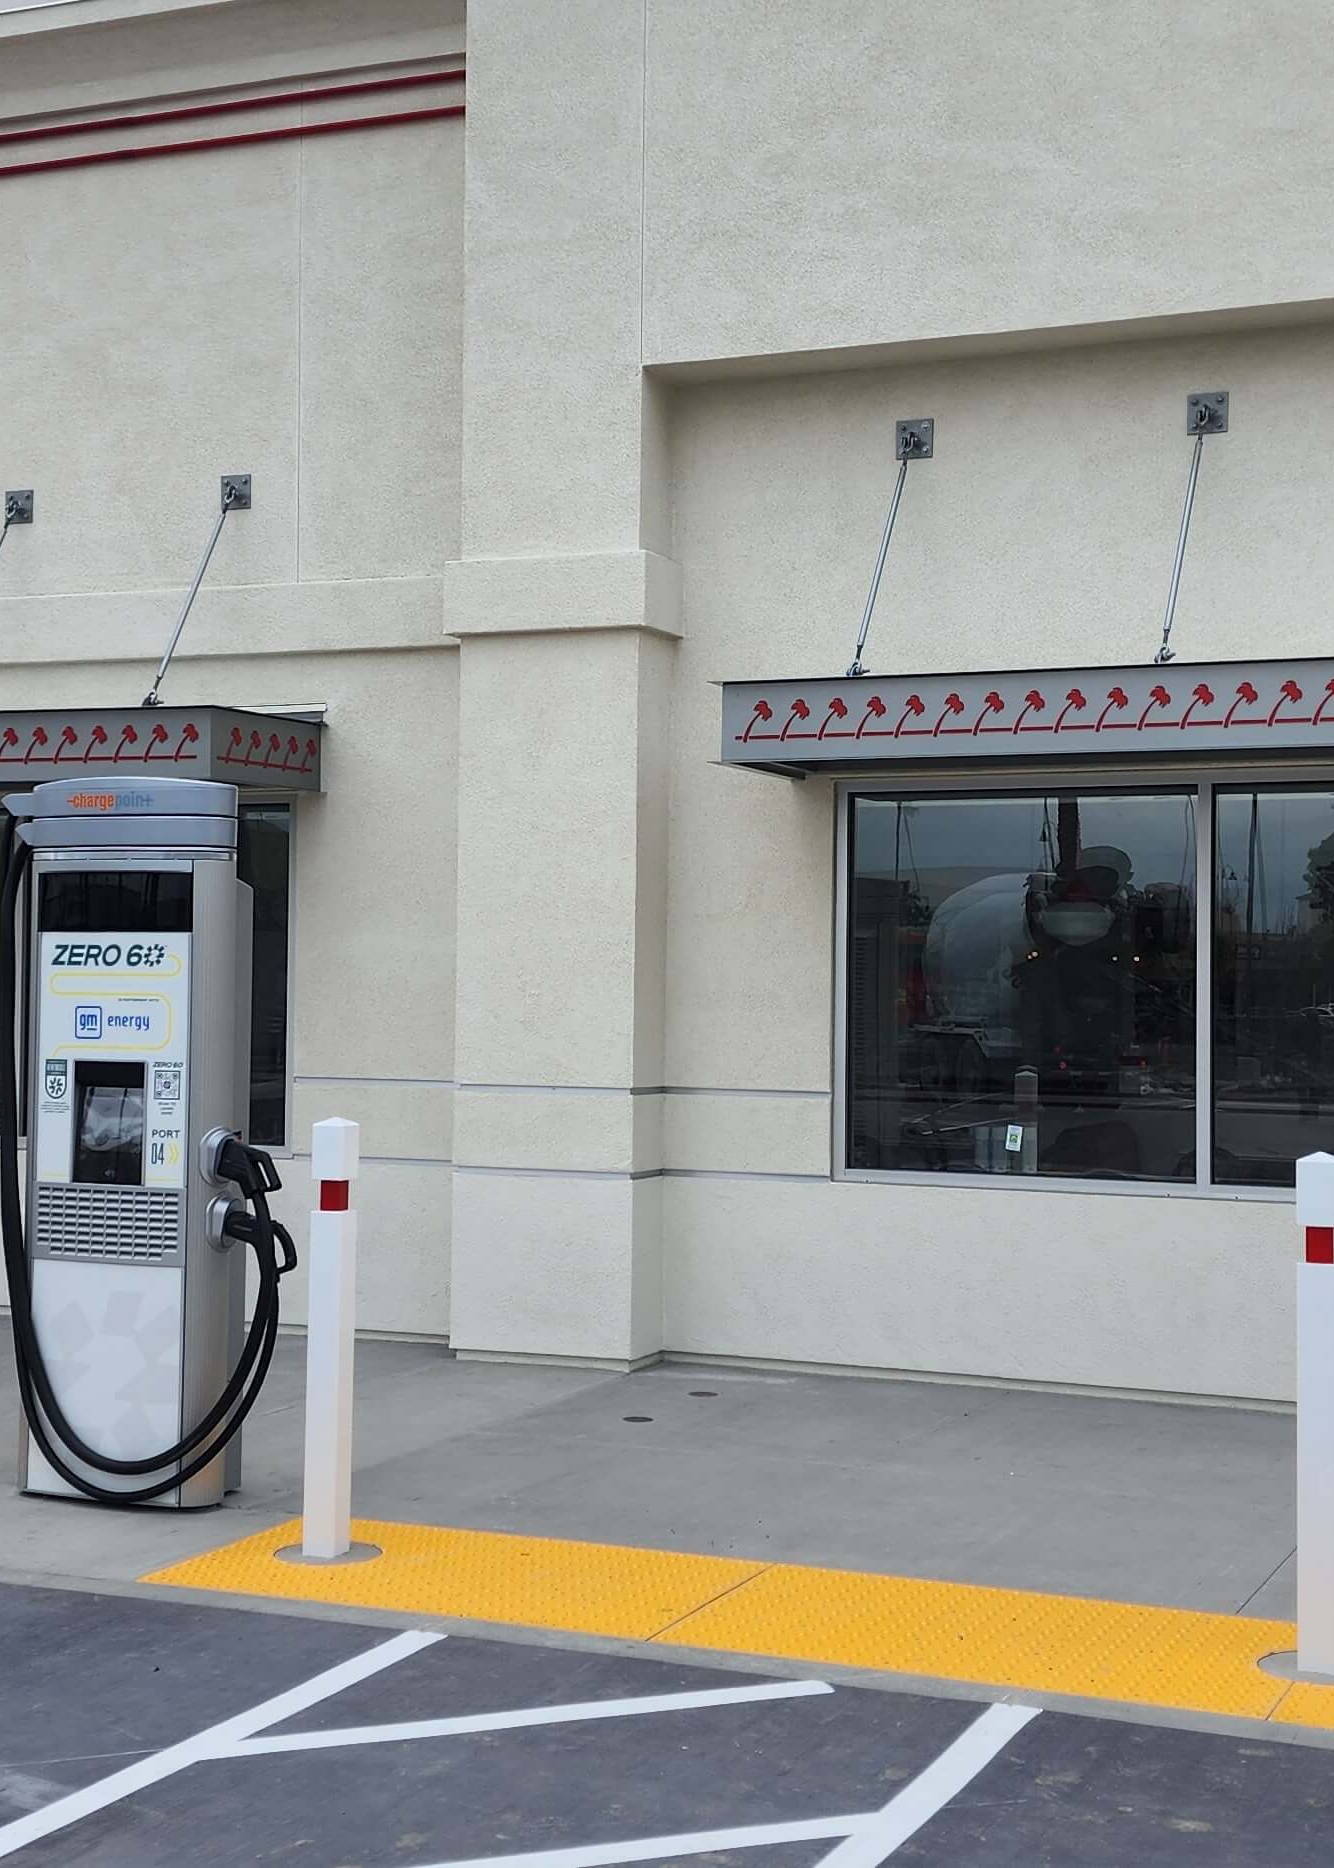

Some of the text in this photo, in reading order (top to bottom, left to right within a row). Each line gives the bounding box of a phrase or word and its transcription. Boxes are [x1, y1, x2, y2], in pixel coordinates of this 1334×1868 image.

[50, 944, 122, 967] ZERO
[79, 1014, 150, 1031] gm energy
[151, 1129, 181, 1138] PORT
[151, 1142, 165, 1165] 04
